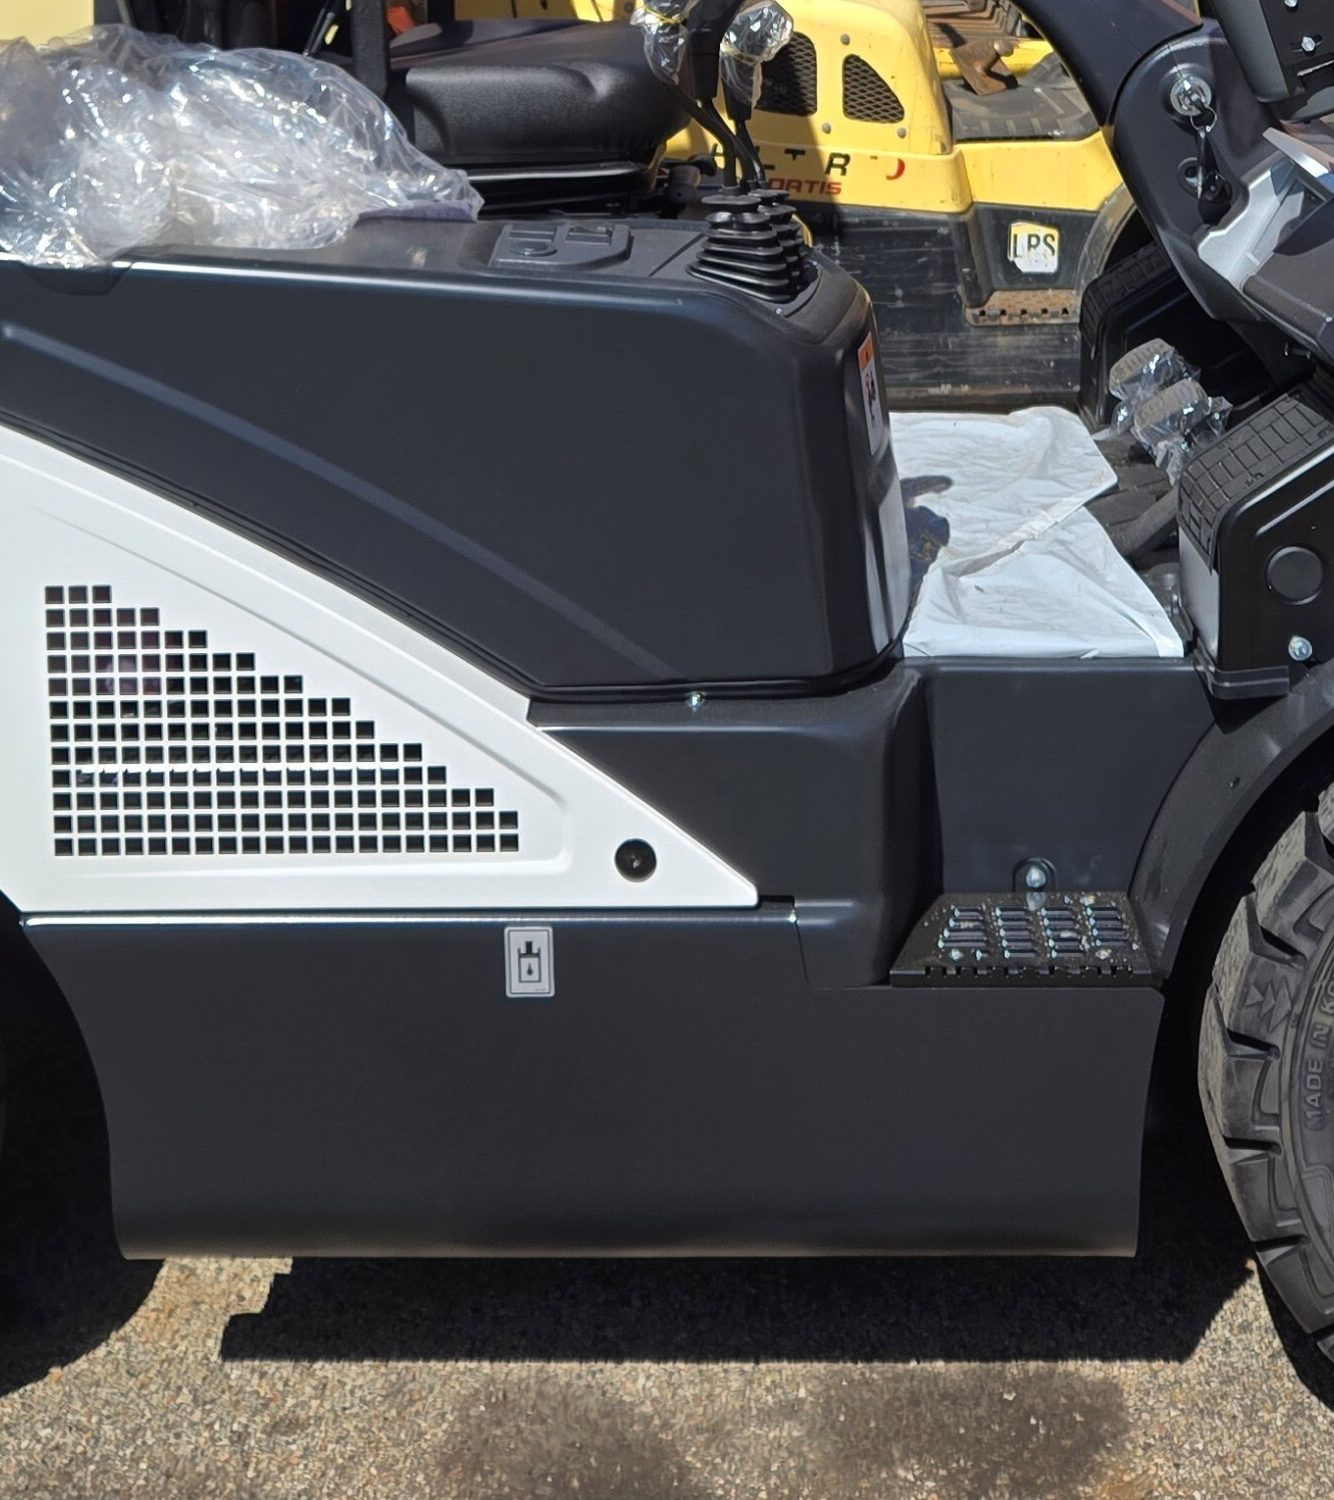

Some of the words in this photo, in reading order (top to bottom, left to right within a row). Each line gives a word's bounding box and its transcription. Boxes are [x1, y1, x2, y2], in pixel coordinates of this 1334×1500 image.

[1012, 233, 1056, 259] LPS
[1310, 1024, 1331, 1050] IN
[1304, 1058, 1324, 1132] MADE
